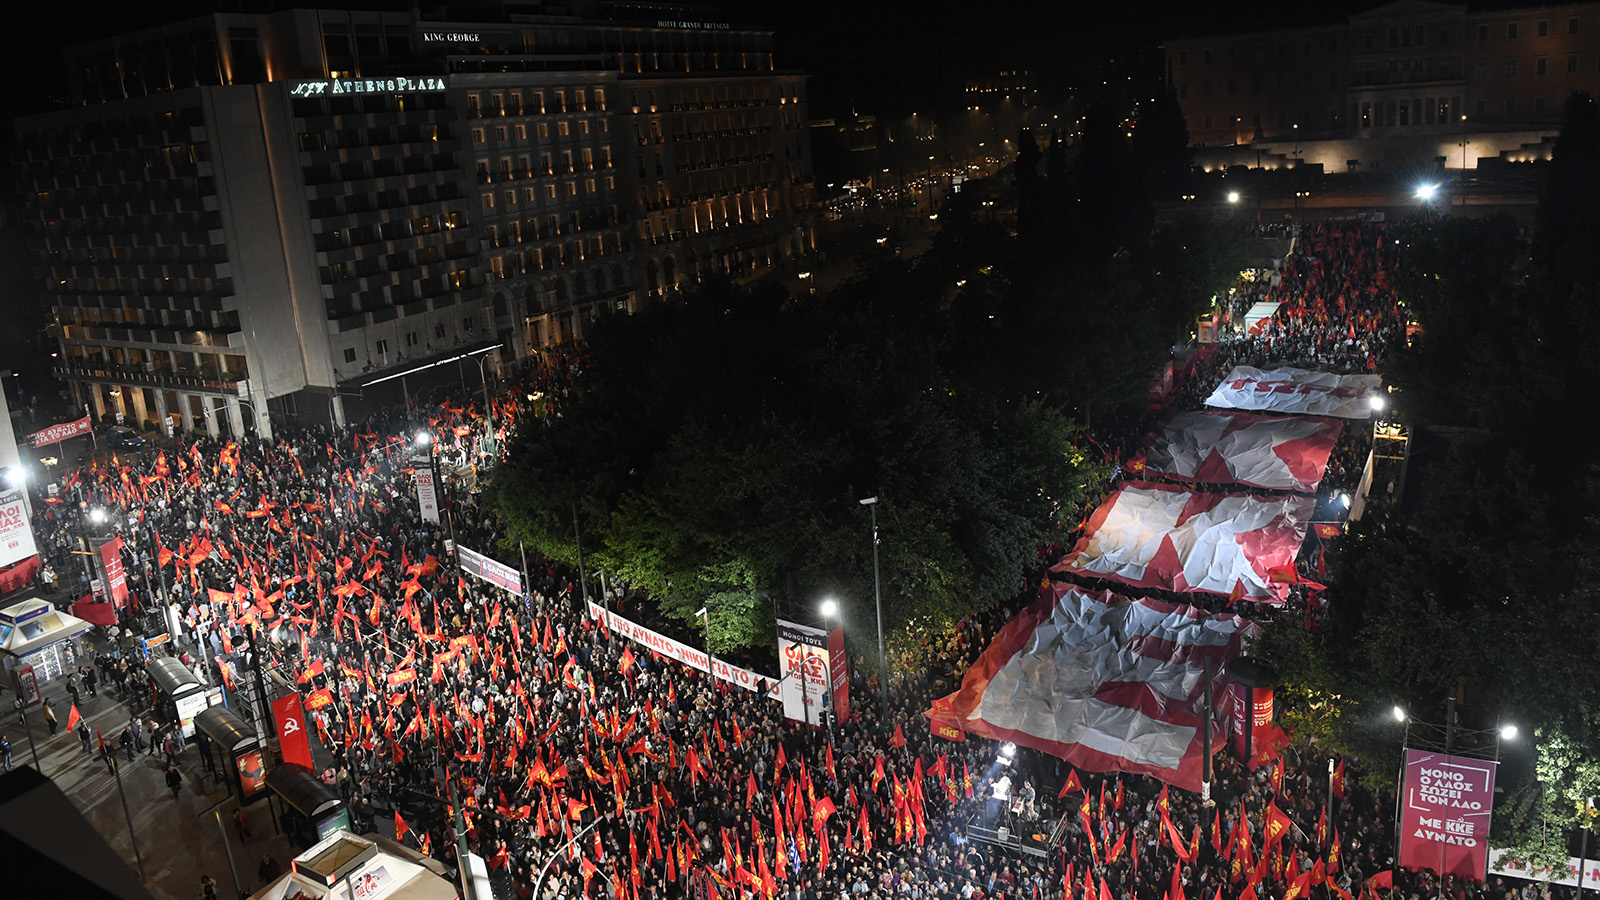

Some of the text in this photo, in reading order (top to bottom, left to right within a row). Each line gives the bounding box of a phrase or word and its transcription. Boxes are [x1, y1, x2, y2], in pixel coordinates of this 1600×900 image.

[424, 33, 480, 42] KING GEORGE
[591, 606, 612, 625] ΚΚ
[613, 616, 630, 634] ΠΙΟ
[632, 627, 674, 653] ΔΥΝΑΤΟ
[682, 650, 709, 670] ΝΙΚΗ
[732, 668, 749, 684] ΤΟ
[805, 636, 822, 646] ΤΟΥΣ
[788, 659, 822, 678] ΜΑΣ
[939, 728, 959, 738] ΚΚΕ
[1421, 767, 1464, 781] ΜΟΝΟ
[1420, 776, 1473, 791] Ο ΛΑΟΣ
[1420, 784, 1461, 799] ΣΩΖΕΙ
[1420, 793, 1481, 810] ΤΟΝ ΛΑΟ
[1420, 816, 1474, 834] ΜΕ ΚΚΕ
[1414, 828, 1476, 847] ΔΥΝΑΤΟ
